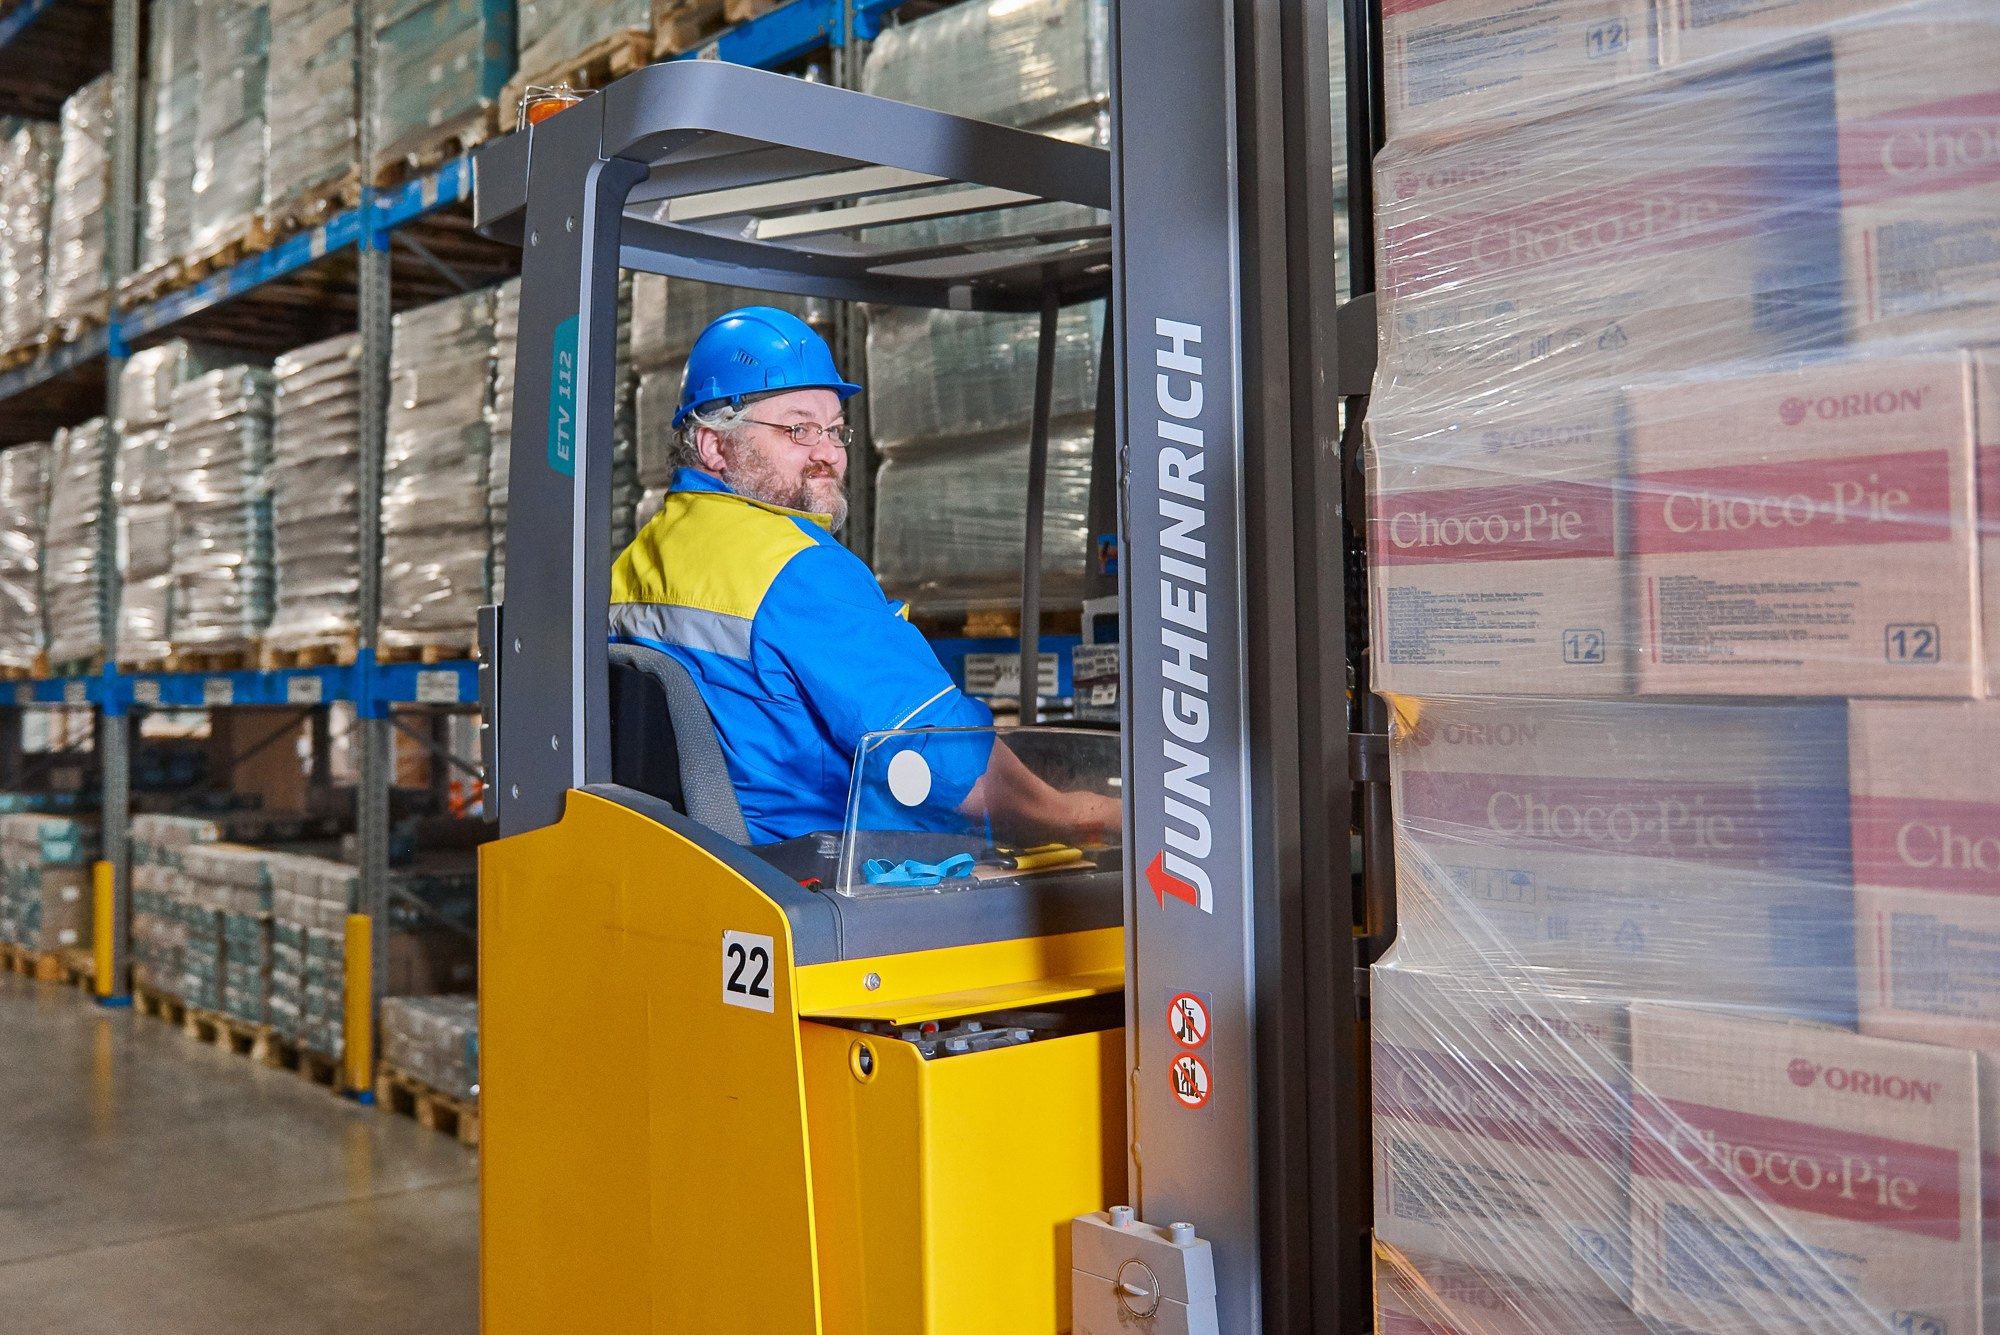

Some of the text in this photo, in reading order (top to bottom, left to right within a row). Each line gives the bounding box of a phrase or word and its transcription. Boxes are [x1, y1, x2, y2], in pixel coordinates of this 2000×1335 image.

[1590, 23, 1625, 53] 12
[1881, 126, 2000, 180] Cho
[557, 350, 572, 461] ETV 112
[1816, 388, 1922, 420] ORION
[1153, 317, 1213, 914] JUNGHEINRICH
[1566, 633, 1601, 660] 12
[1890, 628, 1934, 659] 12
[727, 942, 769, 998] 22
[1824, 1066, 1933, 1105] ORION
